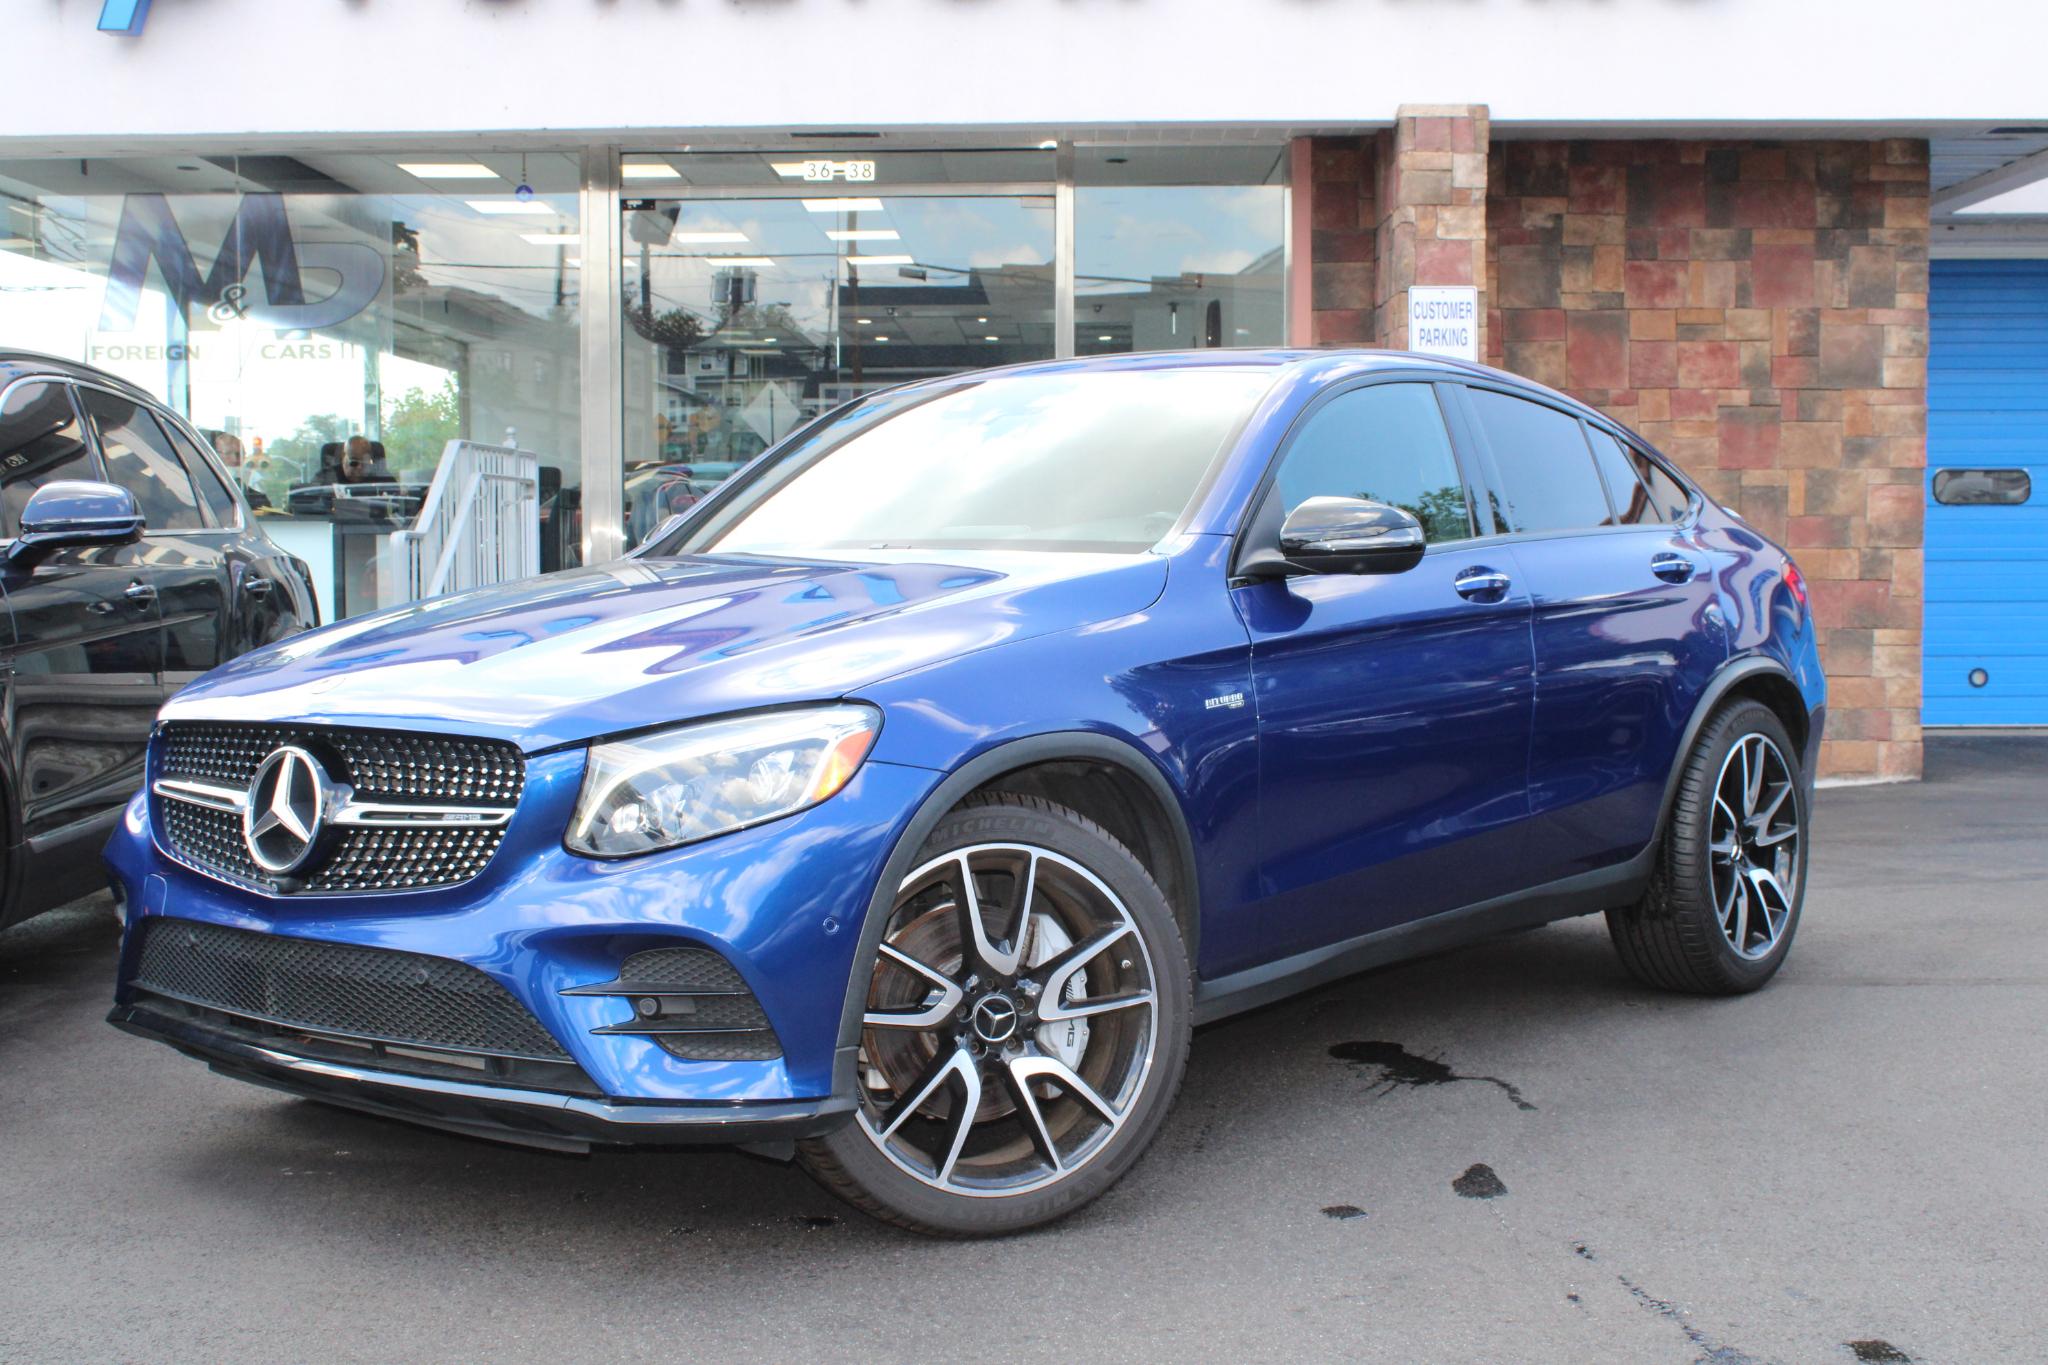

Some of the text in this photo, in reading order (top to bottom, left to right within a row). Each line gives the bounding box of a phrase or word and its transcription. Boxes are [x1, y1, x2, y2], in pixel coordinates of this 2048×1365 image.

[807, 162, 872, 178] 36-38
[1413, 301, 1473, 320] CUSTOMER
[1419, 327, 1468, 347] PARKING
[91, 344, 200, 361] FOREIGN
[260, 343, 331, 360] CARS
[931, 815, 1050, 845] MICHELIN
